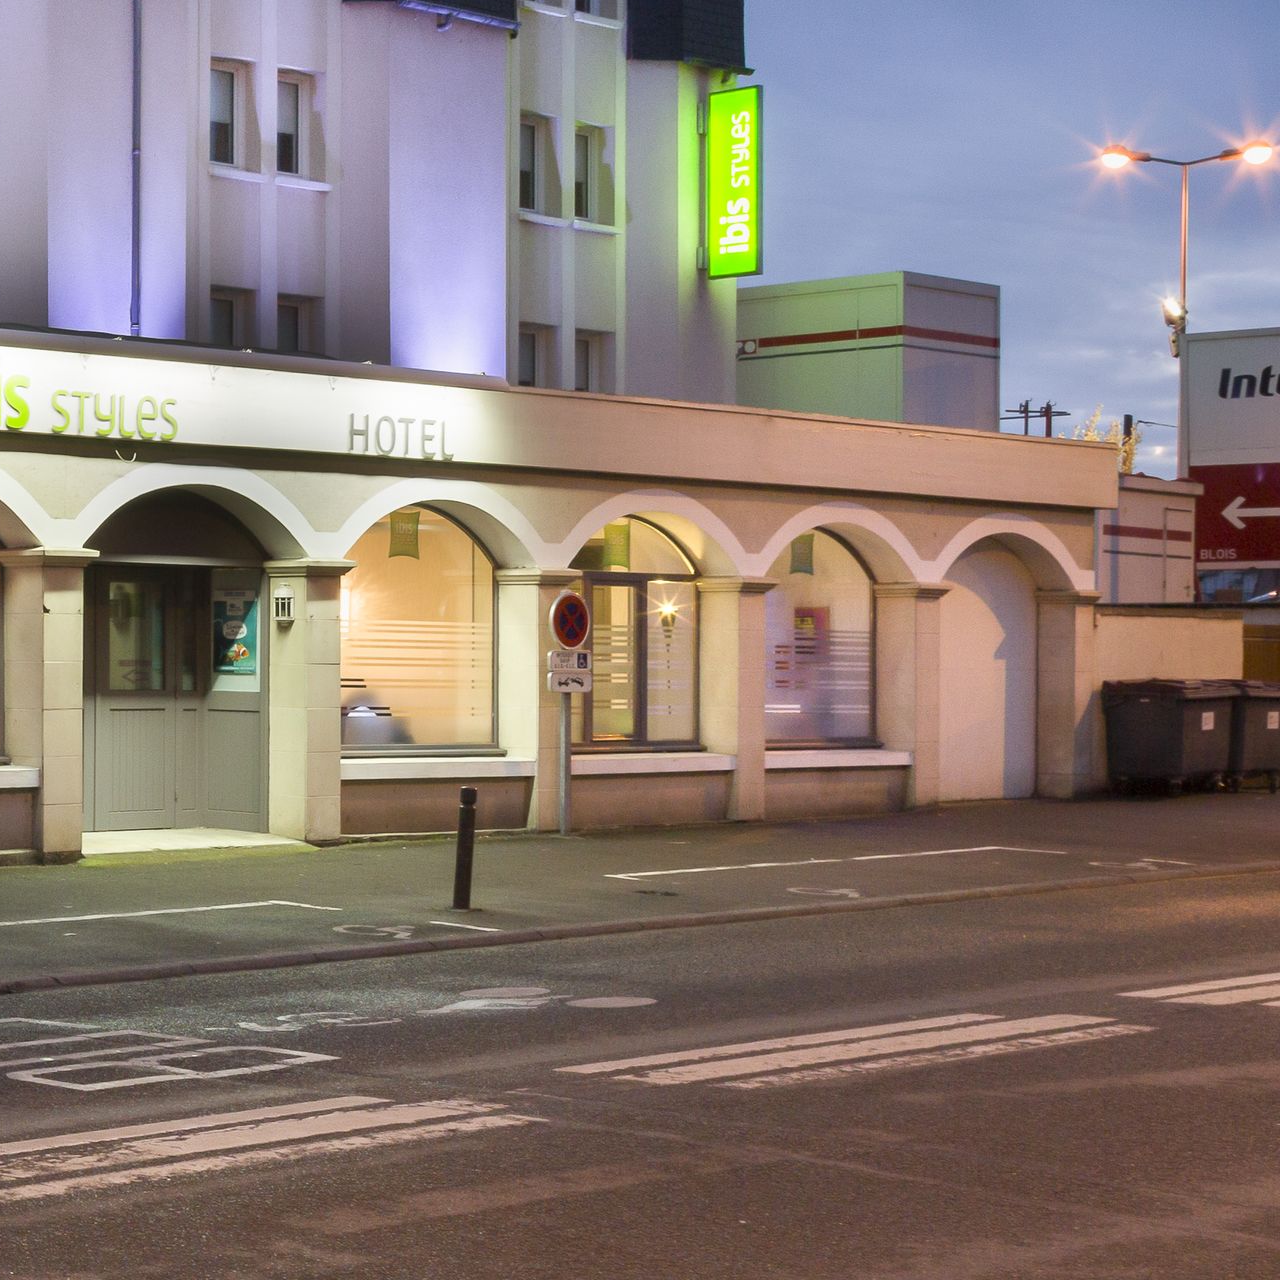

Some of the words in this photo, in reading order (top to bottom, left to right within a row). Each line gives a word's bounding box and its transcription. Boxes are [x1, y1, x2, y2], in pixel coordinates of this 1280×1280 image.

[719, 197, 750, 255] ibis
[1218, 365, 1280, 400] Int
[348, 412, 454, 461] HOTEL
[1200, 548, 1237, 560] BLOIS
